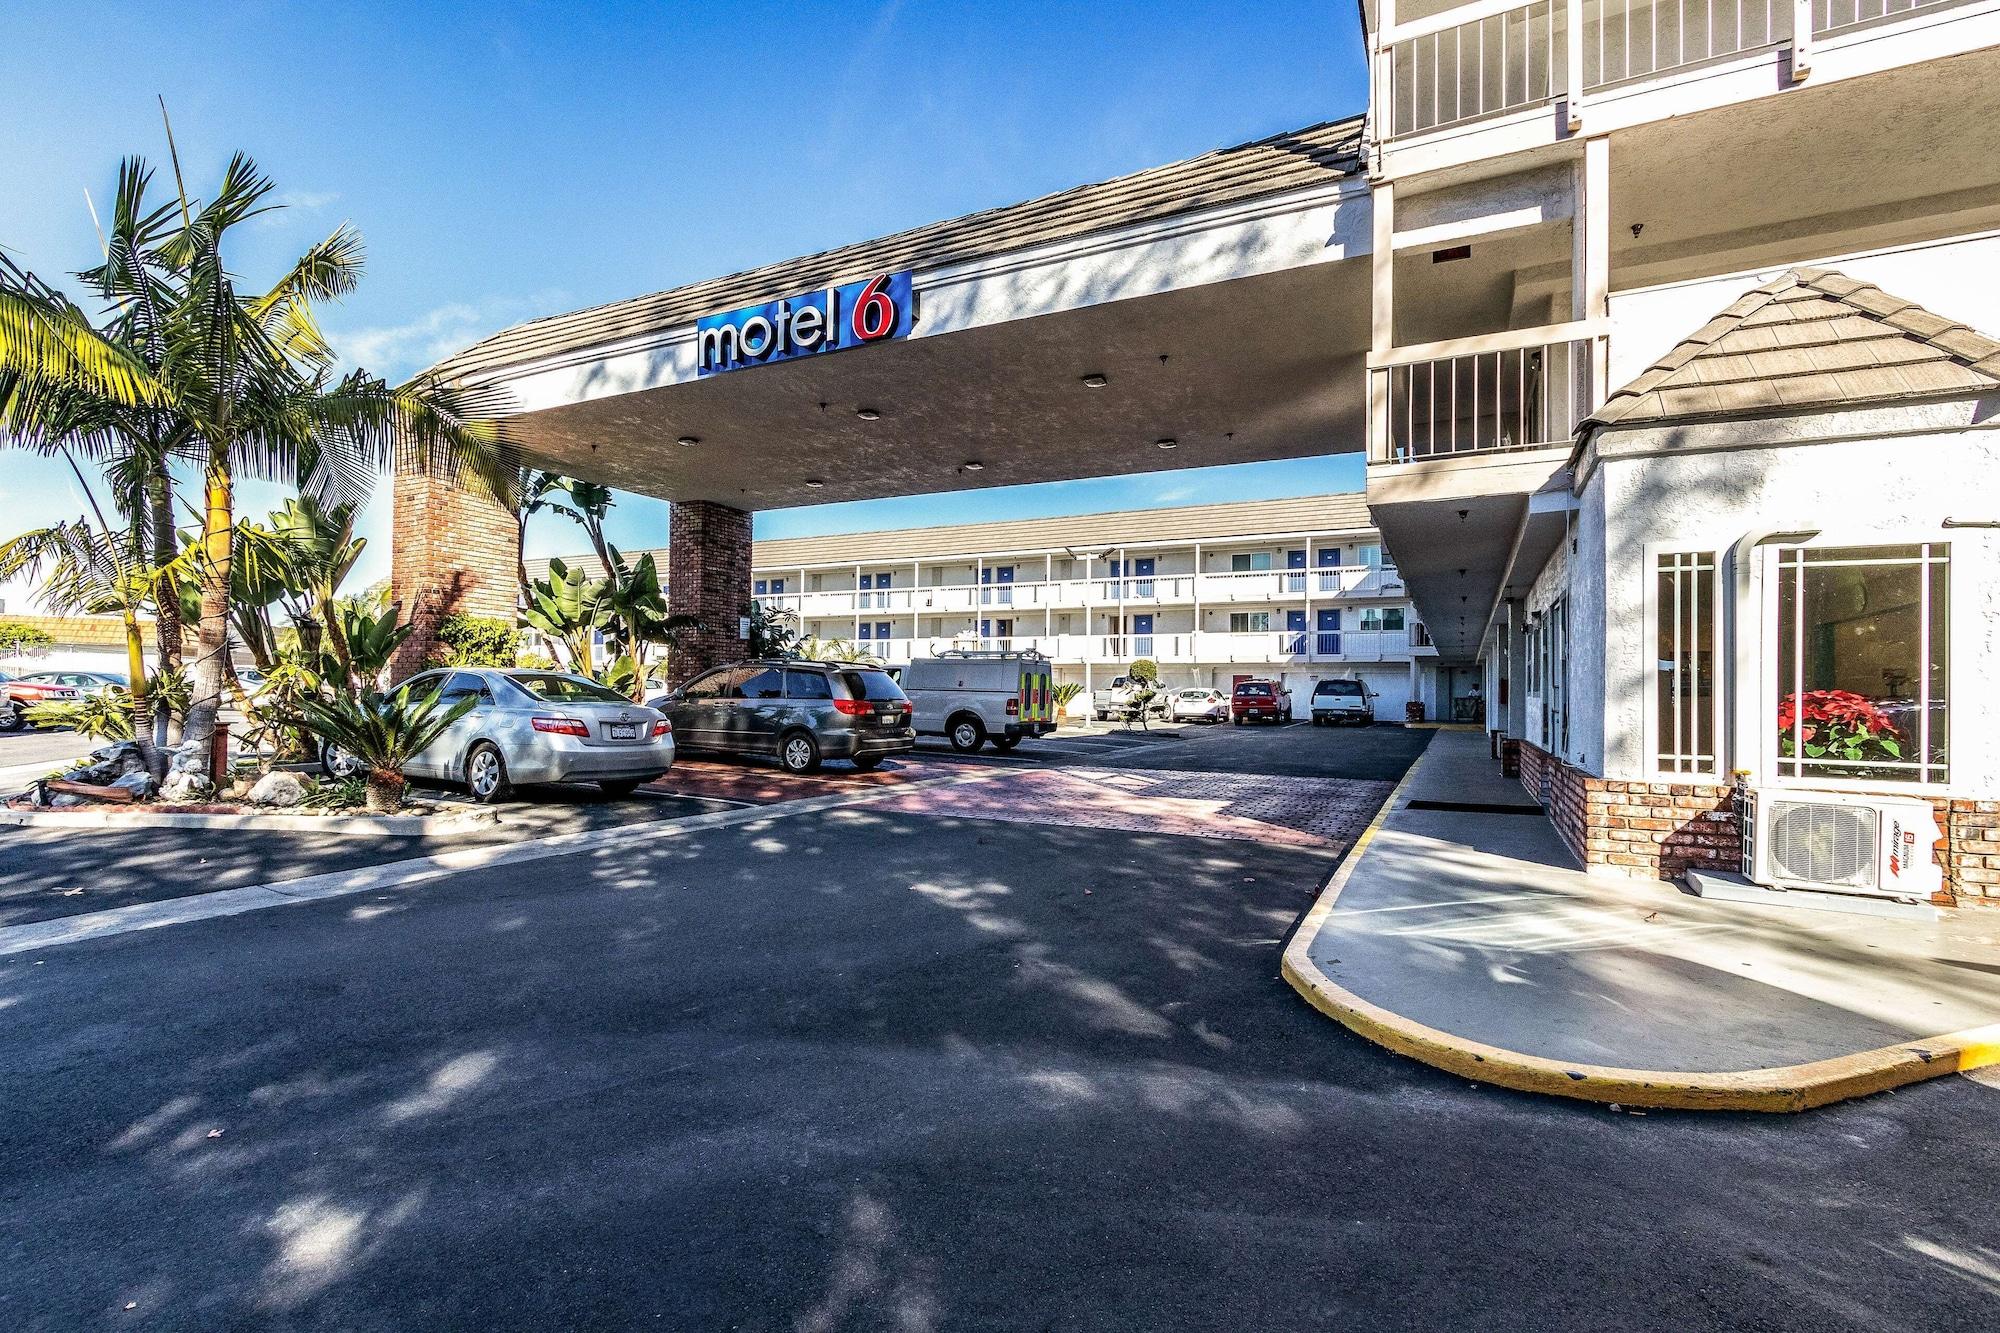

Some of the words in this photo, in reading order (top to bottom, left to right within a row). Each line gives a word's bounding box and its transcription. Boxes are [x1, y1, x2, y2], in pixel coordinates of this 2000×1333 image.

[699, 288, 837, 367] motel
[852, 272, 895, 341] 6
[1892, 820, 1901, 857] mirage
